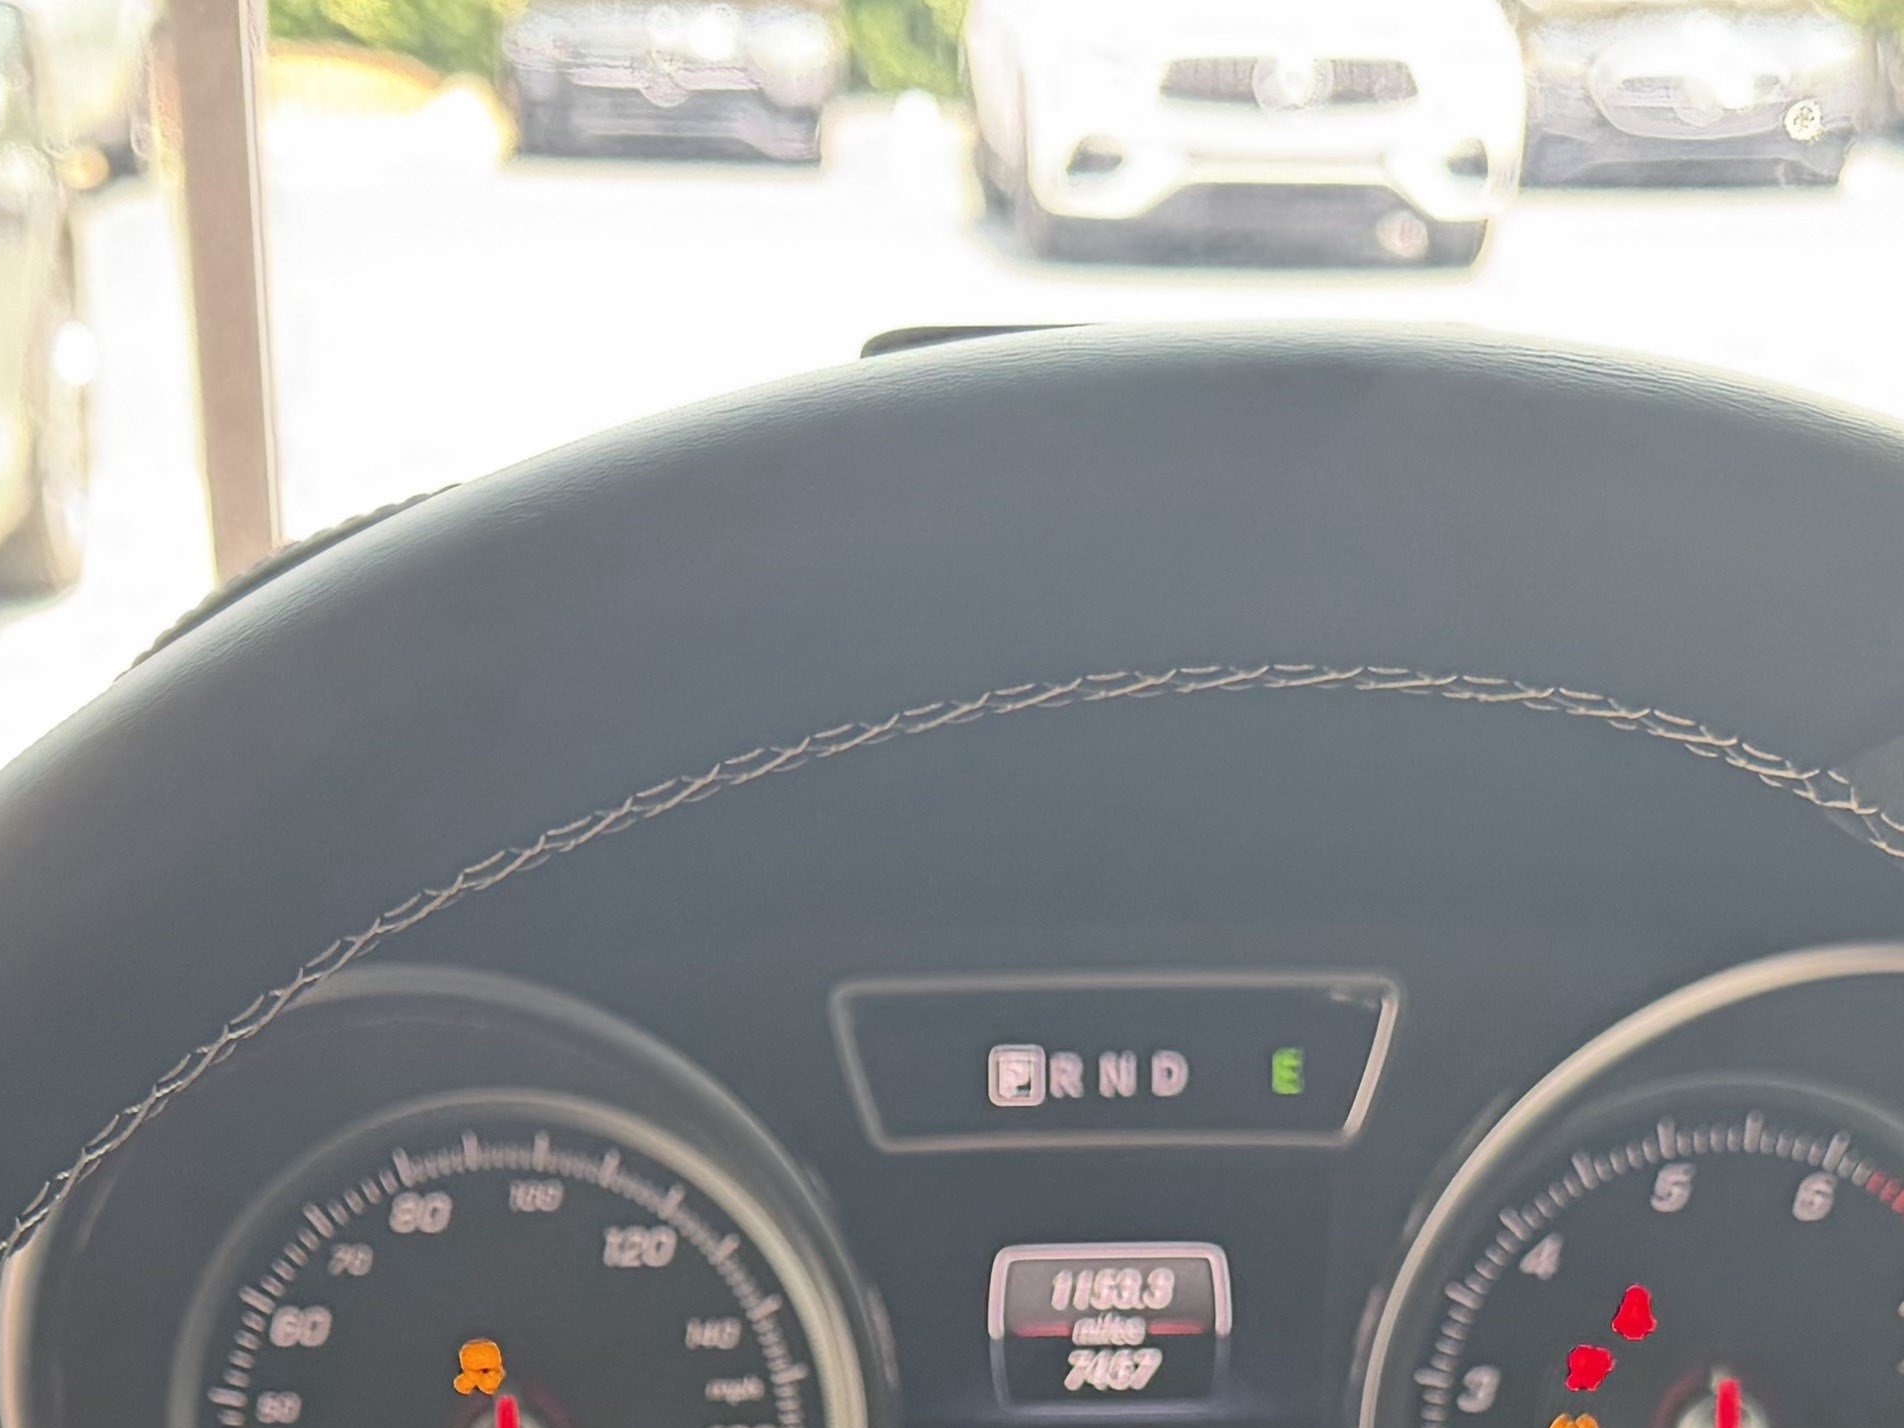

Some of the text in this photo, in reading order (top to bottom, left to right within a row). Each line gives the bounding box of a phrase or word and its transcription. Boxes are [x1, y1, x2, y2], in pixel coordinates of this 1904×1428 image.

[1049, 1052, 1085, 1098] R
[1098, 1050, 1137, 1098] N
[1151, 1049, 1189, 1097] D
[1271, 1047, 1305, 1095] E
[1650, 1162, 1694, 1213] 5
[1791, 1170, 1839, 1222] 6
[389, 1191, 453, 1235] 80
[602, 1224, 677, 1268] 120
[1519, 1233, 1564, 1280] 4
[268, 1304, 333, 1347] 60
[1455, 1364, 1501, 1413] 3
